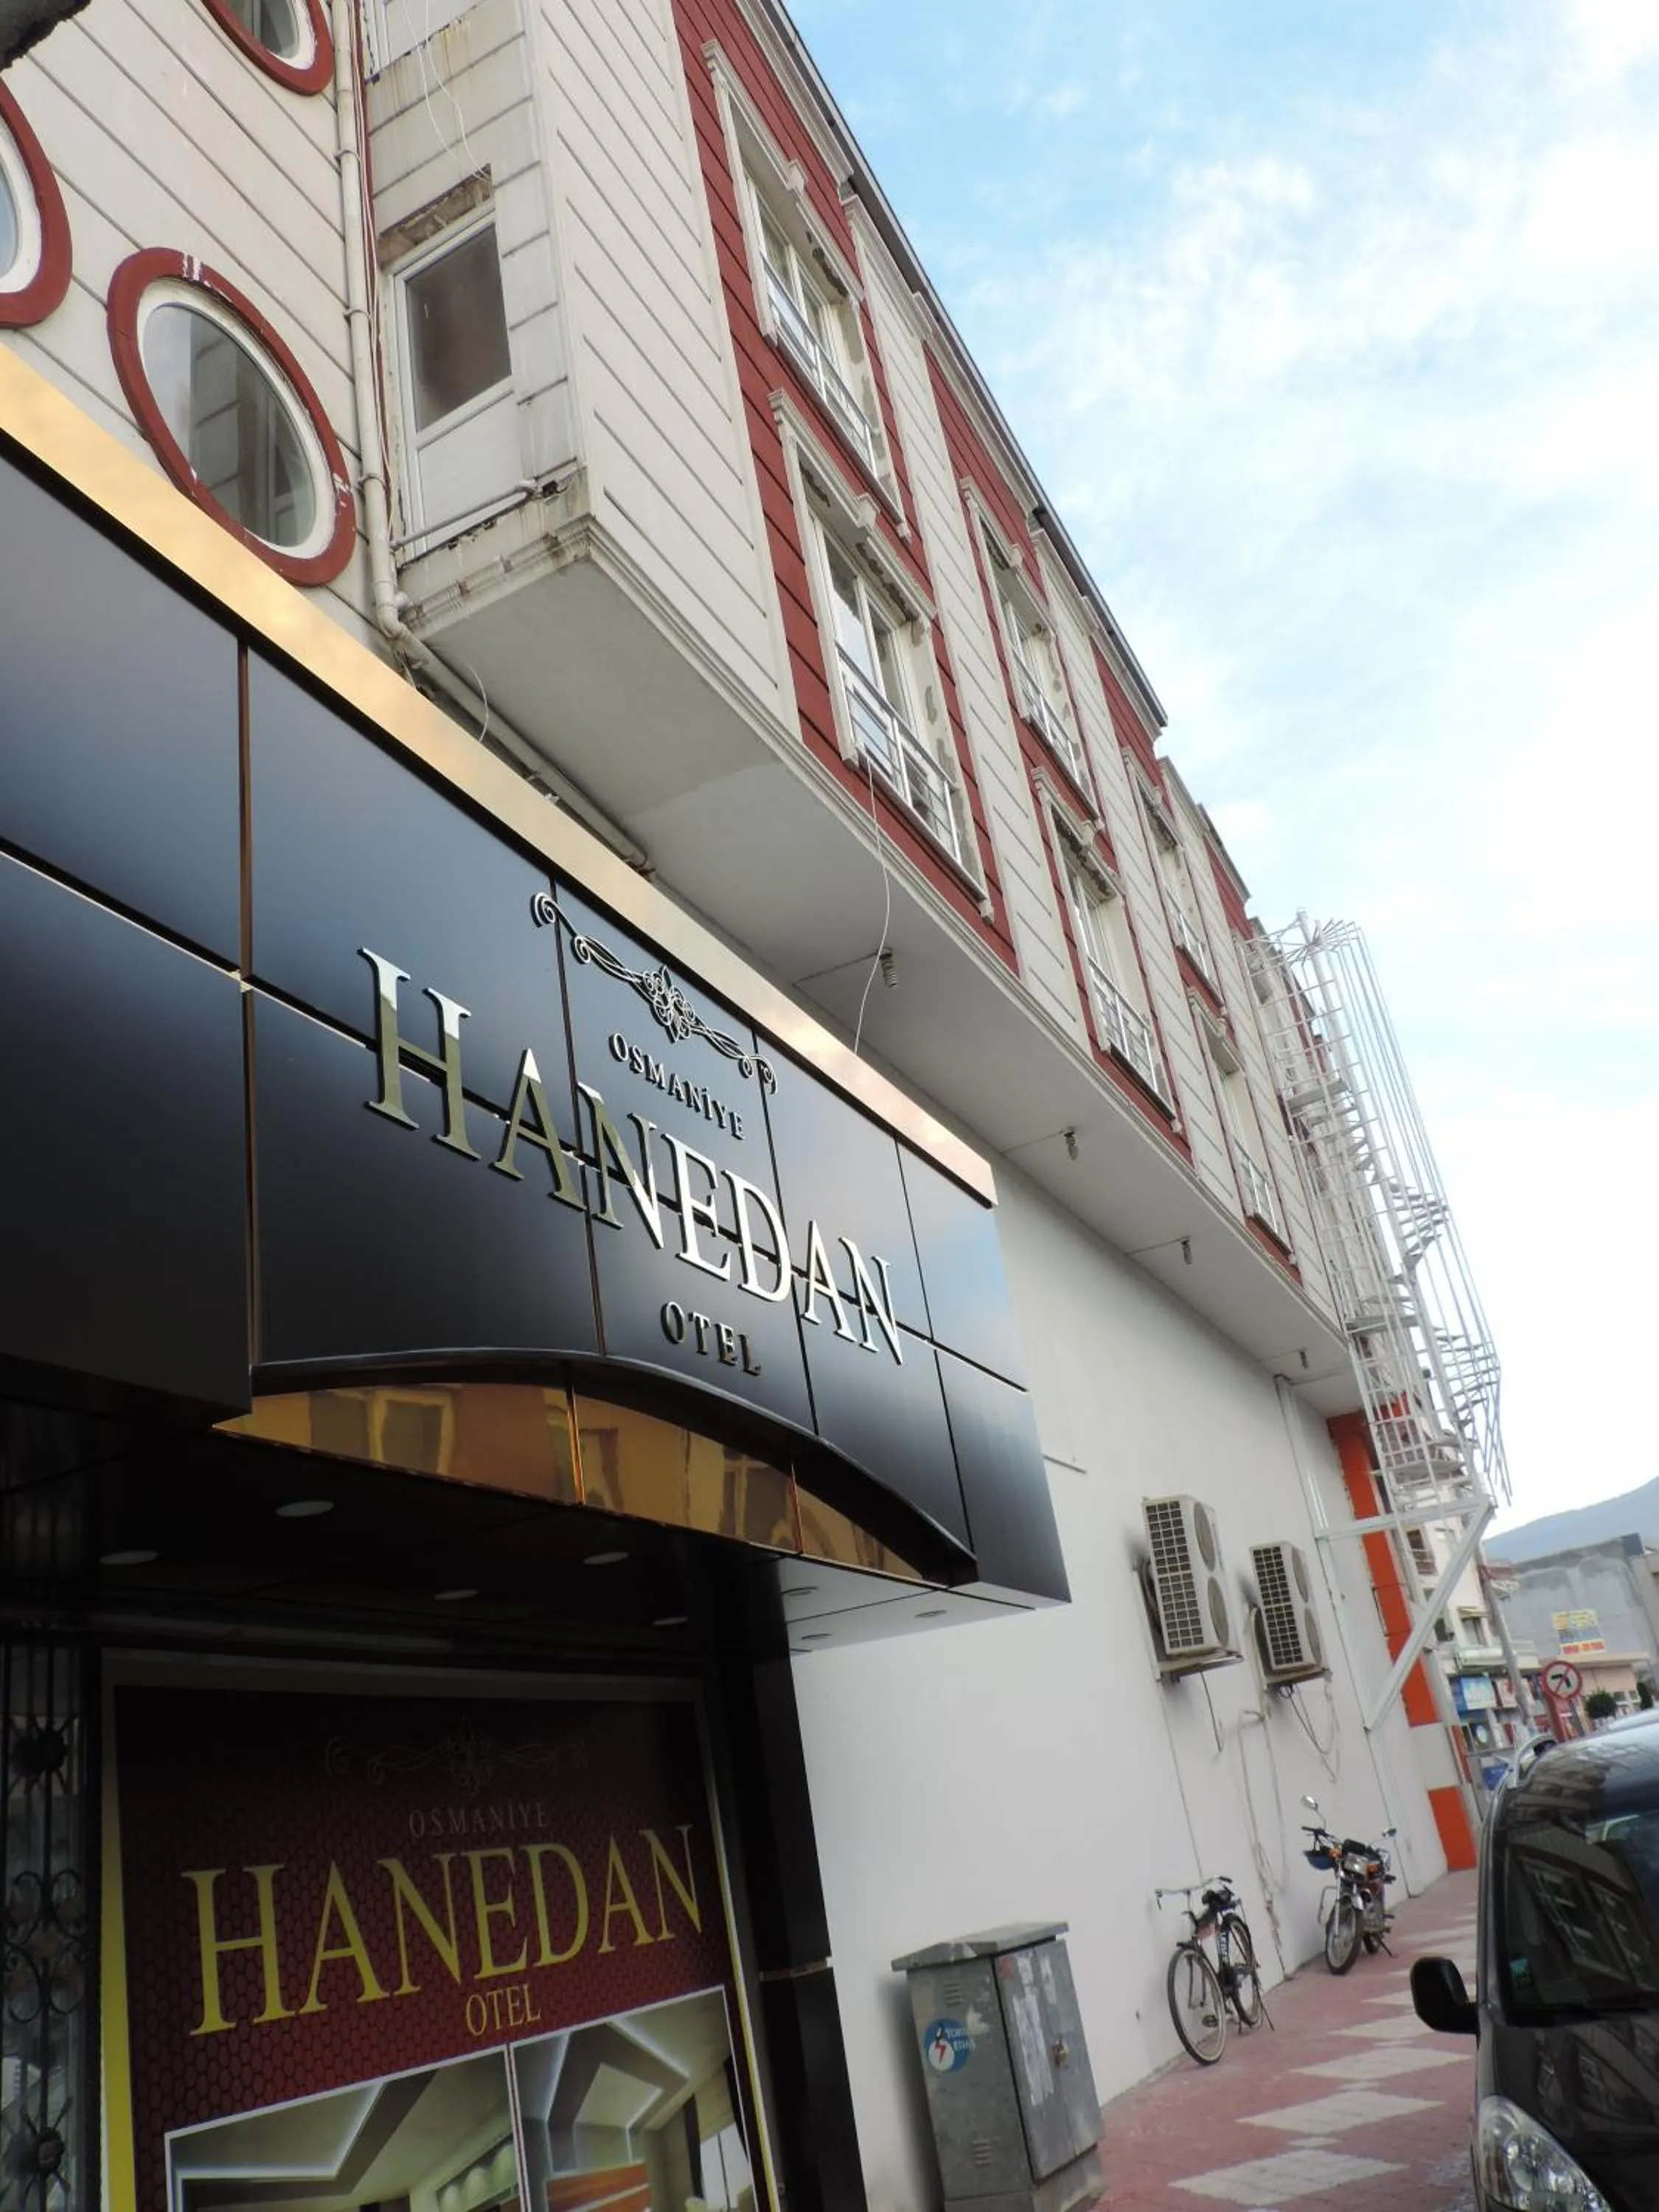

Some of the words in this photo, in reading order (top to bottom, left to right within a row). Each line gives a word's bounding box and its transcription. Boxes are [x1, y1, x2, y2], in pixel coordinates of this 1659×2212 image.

[609, 1033, 745, 1140] OSMANİYE
[358, 947, 902, 1366] HANEDAN
[660, 1301, 763, 1377] OTEL
[182, 1825, 702, 2036] HANEDAN
[465, 1983, 542, 2036] OTEL
